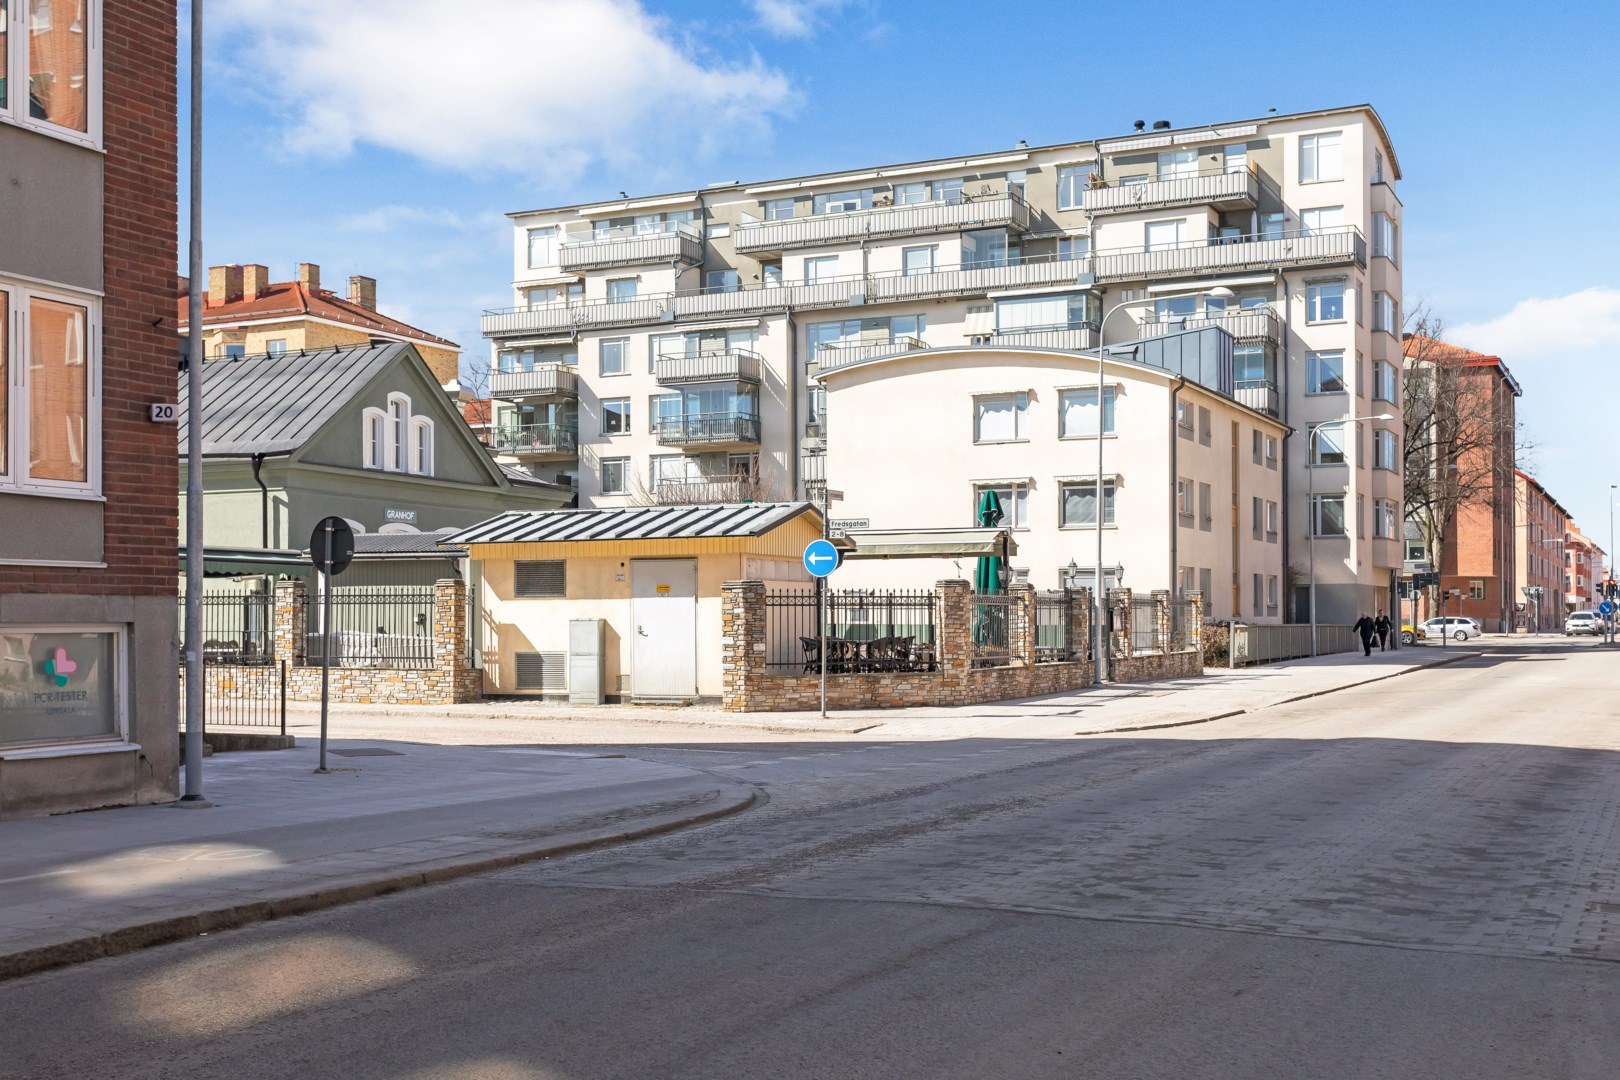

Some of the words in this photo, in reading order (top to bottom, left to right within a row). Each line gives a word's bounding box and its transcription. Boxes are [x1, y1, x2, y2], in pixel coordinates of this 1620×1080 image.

[155, 406, 173, 418] 20
[386, 510, 415, 520] GRANHOF
[34, 690, 88, 703] PCR-TESTER
